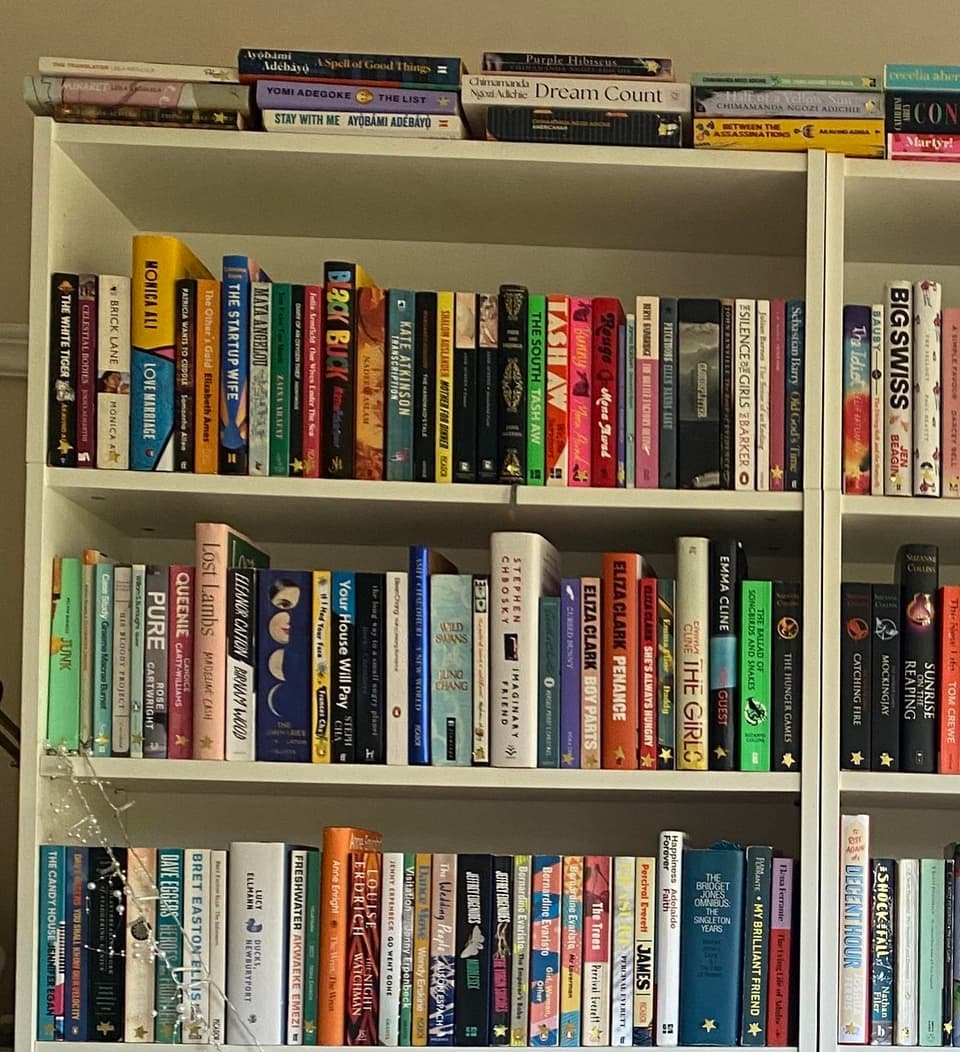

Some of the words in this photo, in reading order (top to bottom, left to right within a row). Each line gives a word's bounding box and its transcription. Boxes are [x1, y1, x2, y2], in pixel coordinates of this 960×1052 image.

[267, 87, 293, 96] YOMI
[296, 90, 351, 100] ADEGOKE
[535, 83, 600, 101] Dream
[605, 85, 662, 103] Count
[275, 113, 297, 124] STAY
[300, 114, 323, 125] WITH
[325, 114, 340, 125] ME
[906, 137, 953, 149] Martyr!
[62, 295, 72, 314] THE
[230, 283, 240, 306] THE
[890, 287, 909, 327] BIG
[62, 316, 71, 348] WHITE
[110, 301, 119, 333] BRICK
[533, 312, 542, 333] THE
[109, 335, 118, 365] LANE
[228, 310, 240, 364] STARTUP
[60, 350, 70, 378] TIGER
[532, 336, 541, 384] SOUTH
[889, 329, 909, 410] SWISS
[143, 362, 156, 394] LOVE
[227, 367, 239, 401] WIFE
[143, 396, 155, 441] MARRIAGE
[339, 579, 351, 610] Your
[613, 560, 626, 601] ELIZA
[148, 590, 165, 650] PURE
[176, 572, 189, 637] QUEENIE
[338, 614, 350, 655] House
[612, 603, 626, 650] CLARK
[338, 657, 350, 678] Will
[146, 662, 154, 730] CARTWRIGHT
[337, 684, 349, 710] Pay
[612, 655, 626, 721] PENANCE
[904, 660, 915, 720] REAPING
[924, 662, 935, 720] SUNRISE
[294, 855, 303, 931] FRESHWATER
[754, 903, 763, 918] MY
[292, 935, 302, 989] AKWAEKE
[636, 944, 650, 990] JAMES
[752, 921, 762, 978] BRILLIANT
[291, 993, 300, 1028] EMEZI
[750, 981, 760, 1016] FRIEND
